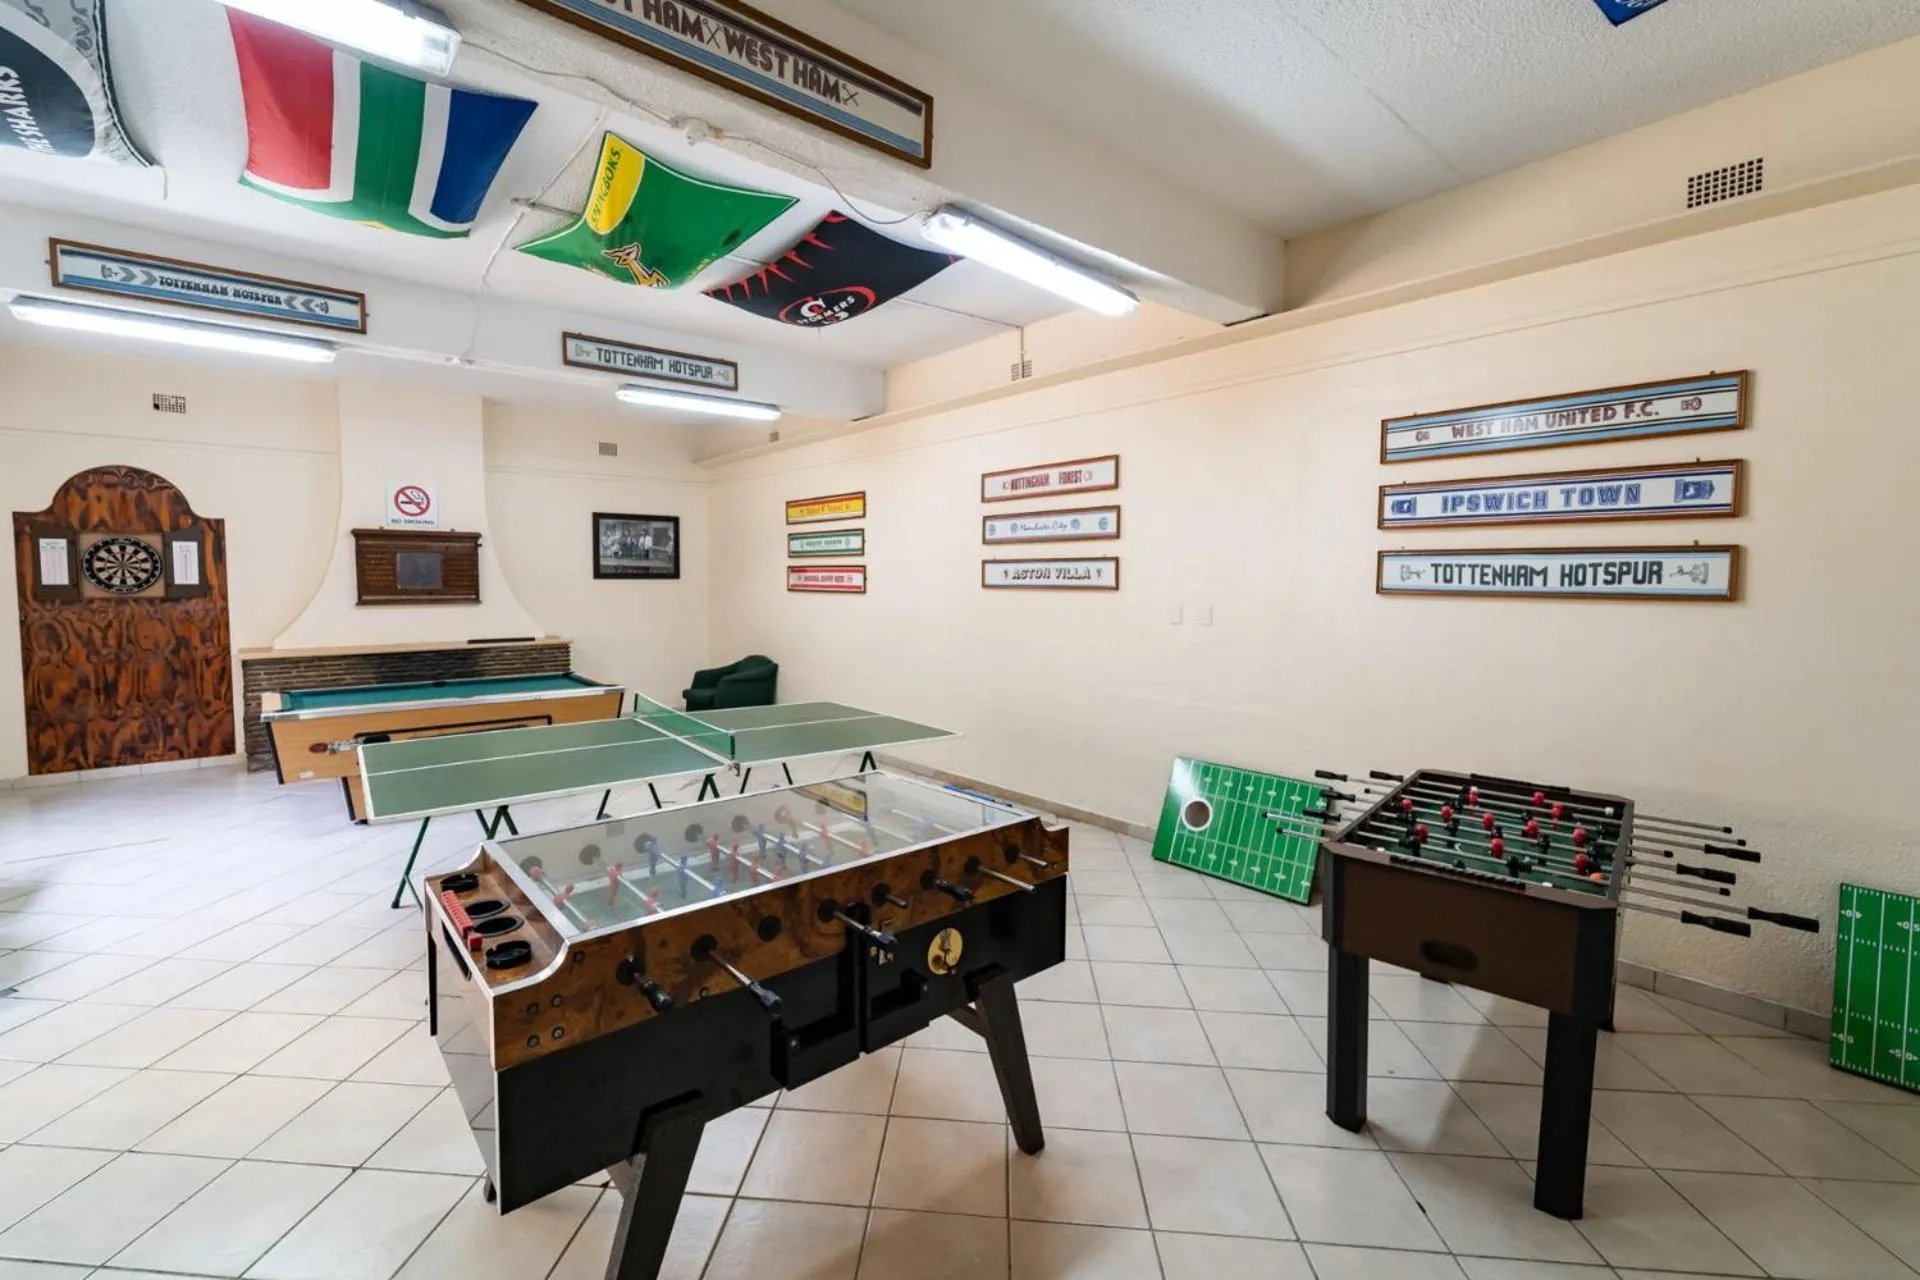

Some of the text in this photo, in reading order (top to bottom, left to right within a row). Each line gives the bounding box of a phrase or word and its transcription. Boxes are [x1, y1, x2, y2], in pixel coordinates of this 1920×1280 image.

[722, 26, 789, 80] WEST
[792, 59, 841, 104] HAM
[591, 147, 621, 223] SPRGBOKS
[158, 275, 283, 306] TOTTENHAM HOTSPUR
[596, 347, 713, 380] TOTTENHAM HOTSPUR
[1451, 400, 1660, 440] WEST HAM UNITED F.C.
[1058, 469, 1083, 486] FOREST
[1440, 482, 1642, 514] IPSWICH TOWN
[1012, 566, 1091, 581] ASTON VILLA
[1430, 560, 1664, 588] TOTTENHAM HOTSPUR
